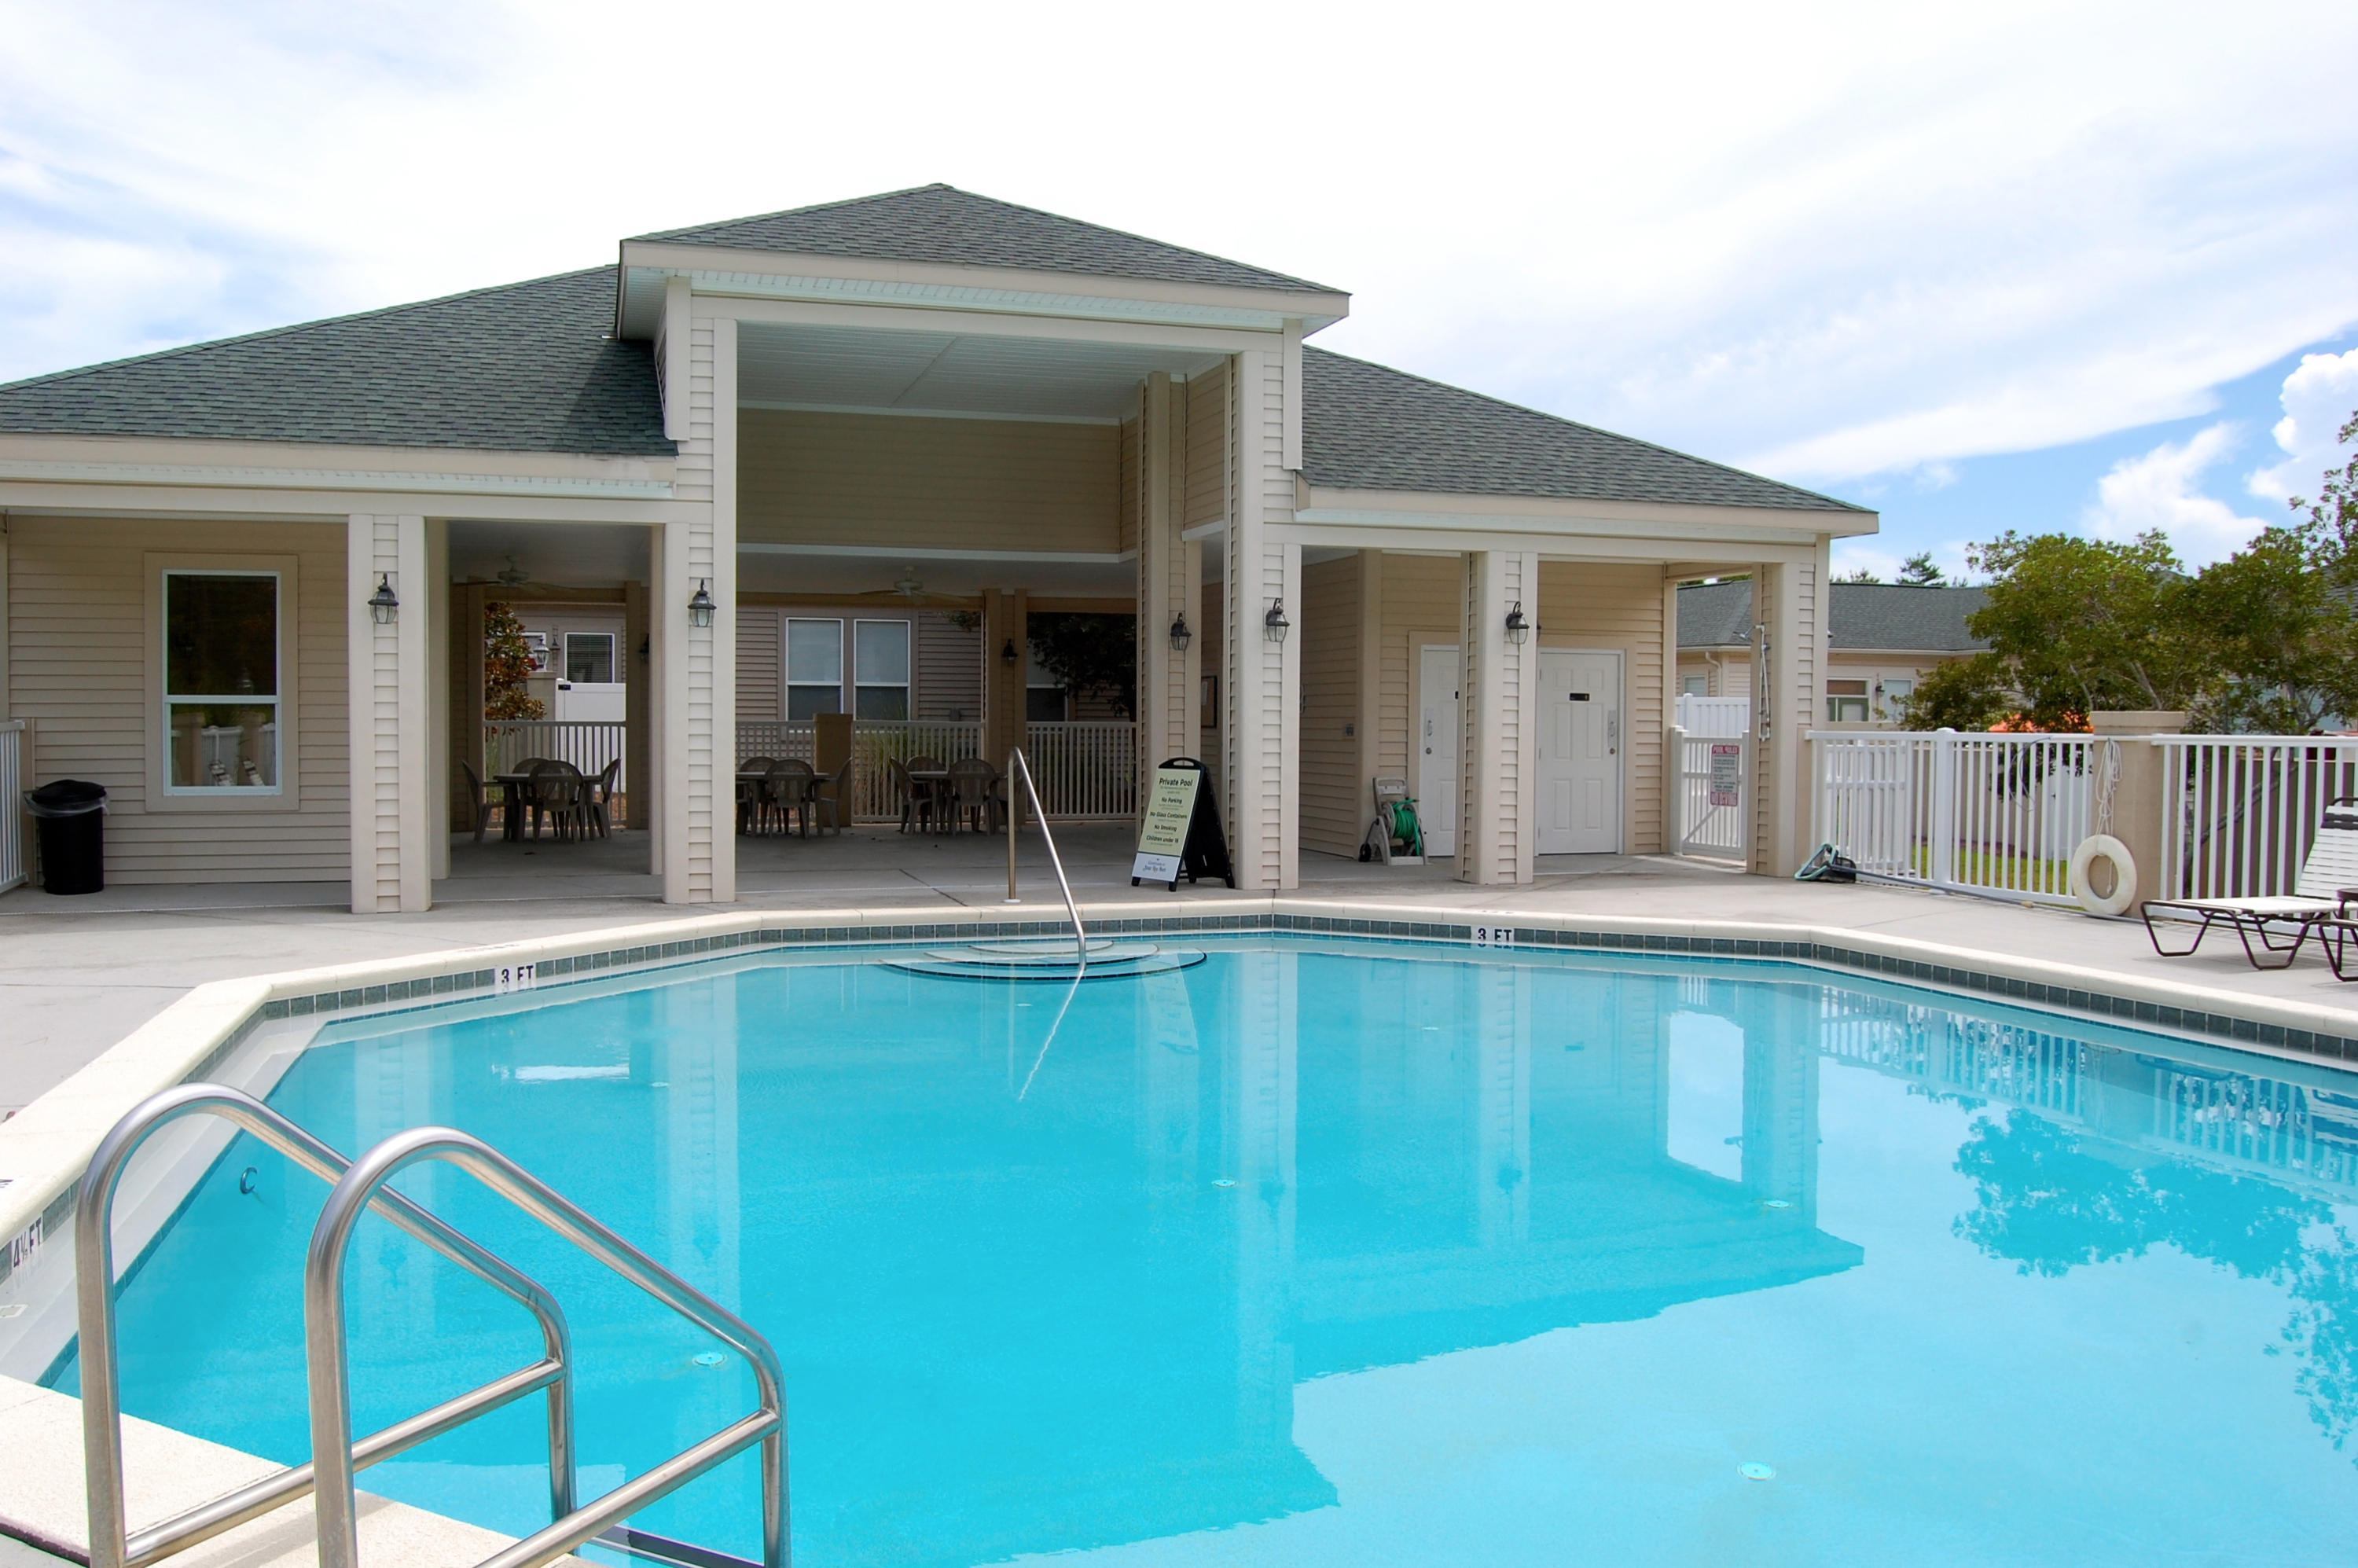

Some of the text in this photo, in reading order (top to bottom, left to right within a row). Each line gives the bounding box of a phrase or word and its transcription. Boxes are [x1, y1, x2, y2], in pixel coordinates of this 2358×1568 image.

[1159, 777, 1193, 787] Private Pool
[1478, 927, 1512, 942] 3 FT
[501, 964, 534, 983] 3 FT
